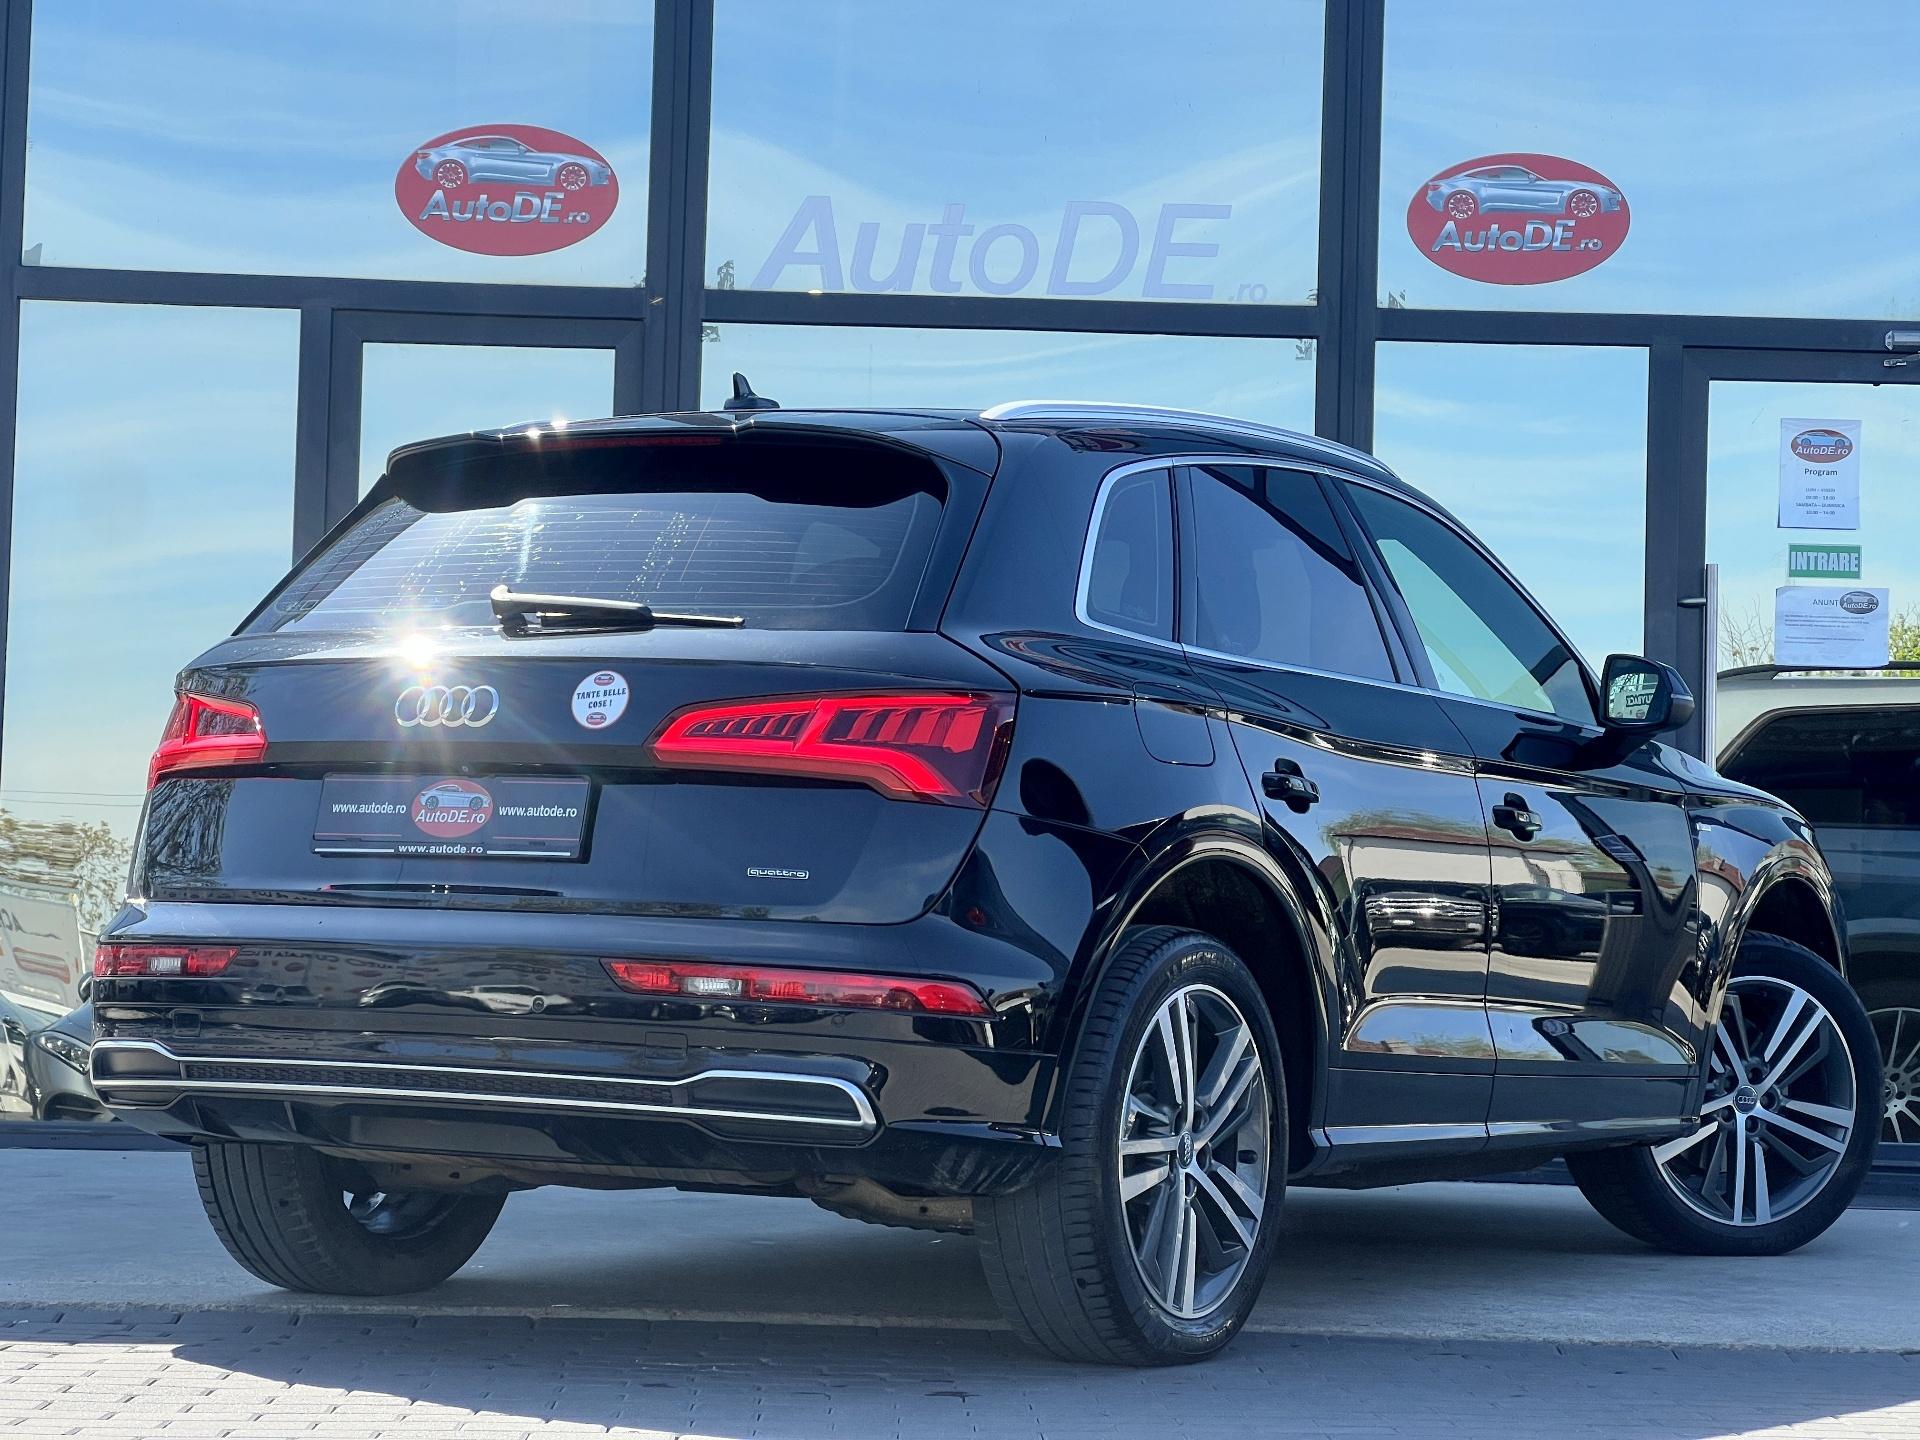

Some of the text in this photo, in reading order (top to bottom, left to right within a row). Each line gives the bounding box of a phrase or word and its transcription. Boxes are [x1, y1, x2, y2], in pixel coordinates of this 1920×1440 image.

[1795, 446, 1849, 455] AutoDE.ro
[1804, 468, 1838, 477] Program
[1790, 551, 1859, 572] INTRARE
[576, 687, 627, 701] TANTE BELLE
[588, 699, 608, 709] COSE
[332, 802, 407, 814] www.autode.ro
[498, 805, 578, 818] www.autode.ro
[414, 809, 486, 824] AutoDE.ro
[398, 844, 484, 855] www.autode.ro
[749, 869, 808, 878] quattro
